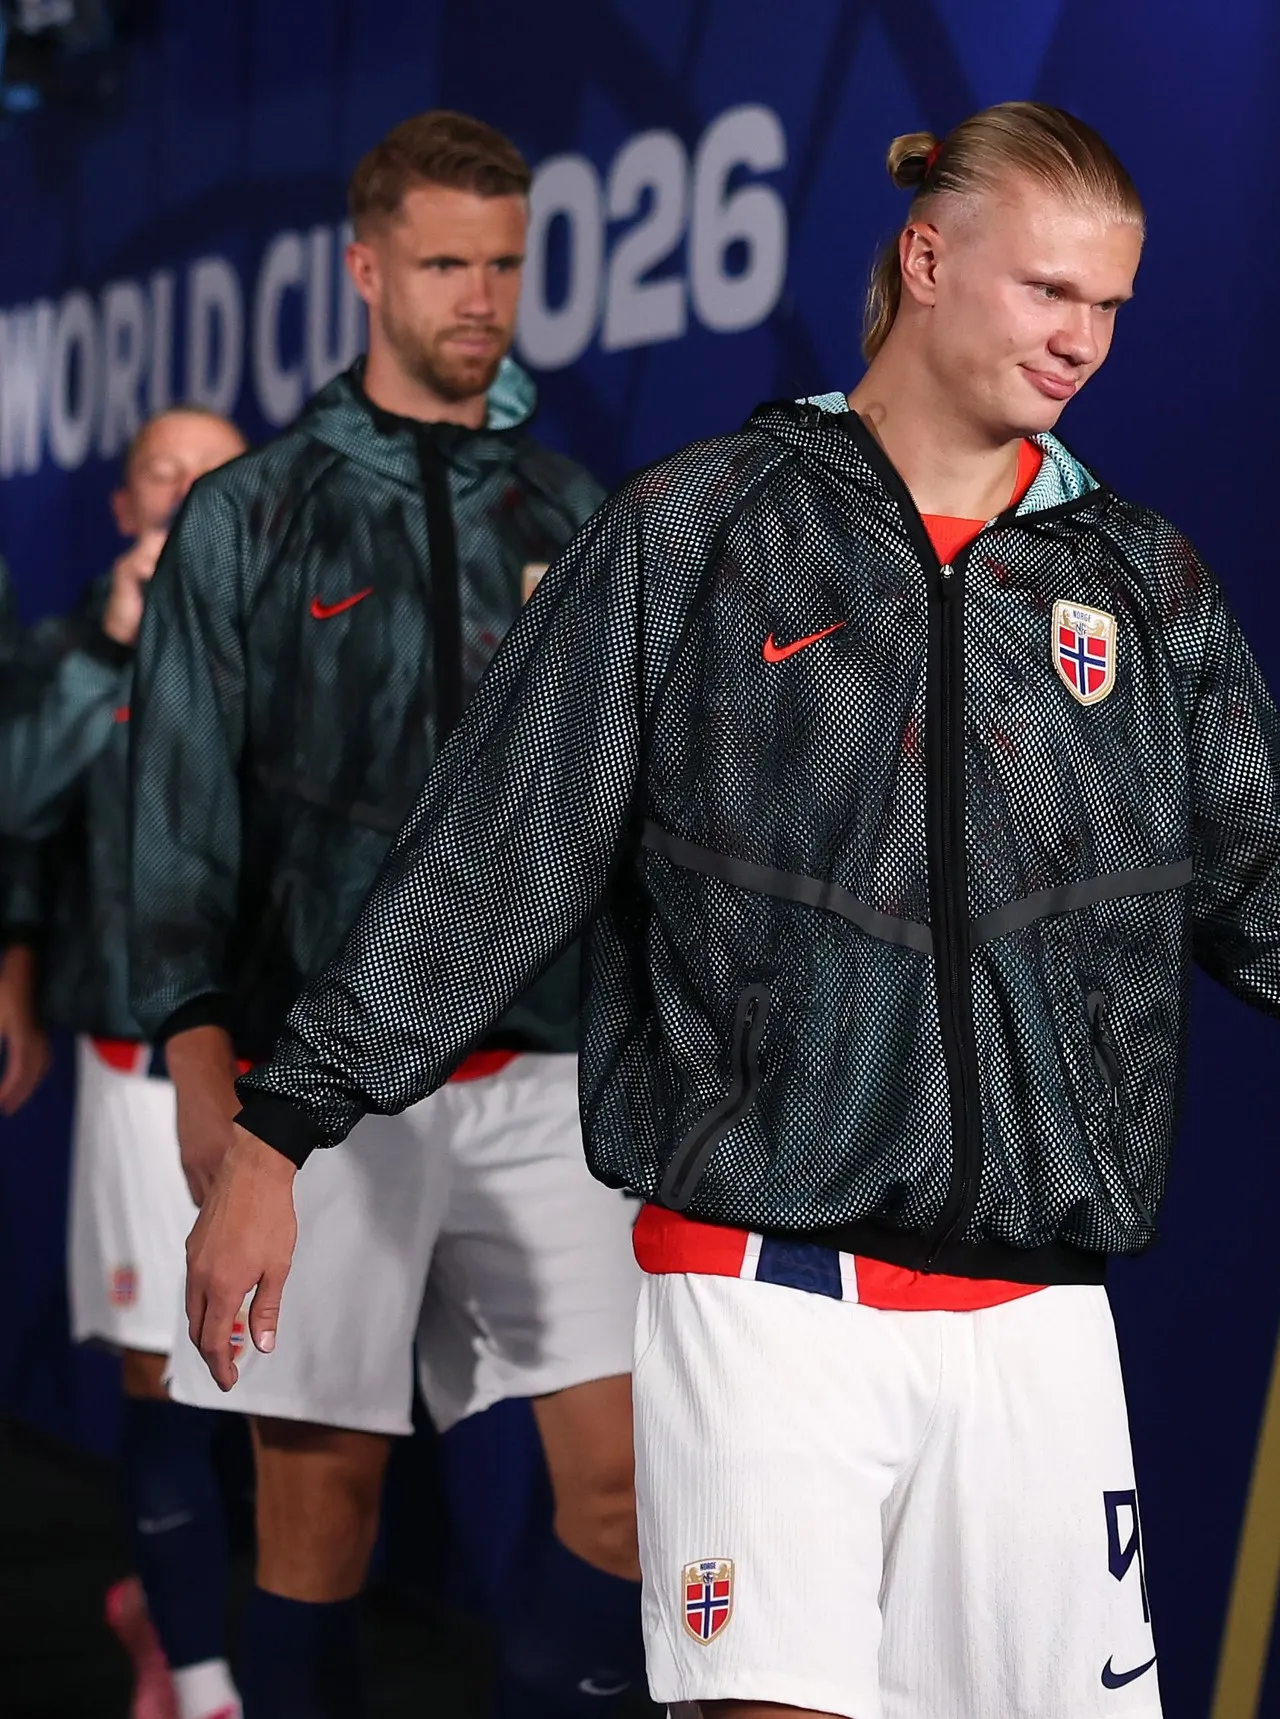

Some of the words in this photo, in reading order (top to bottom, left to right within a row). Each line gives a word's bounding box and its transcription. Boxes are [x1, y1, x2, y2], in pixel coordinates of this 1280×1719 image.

[254, 223, 366, 426] CU
[516, 103, 788, 371] 026
[1073, 610, 1092, 622] NORGE
